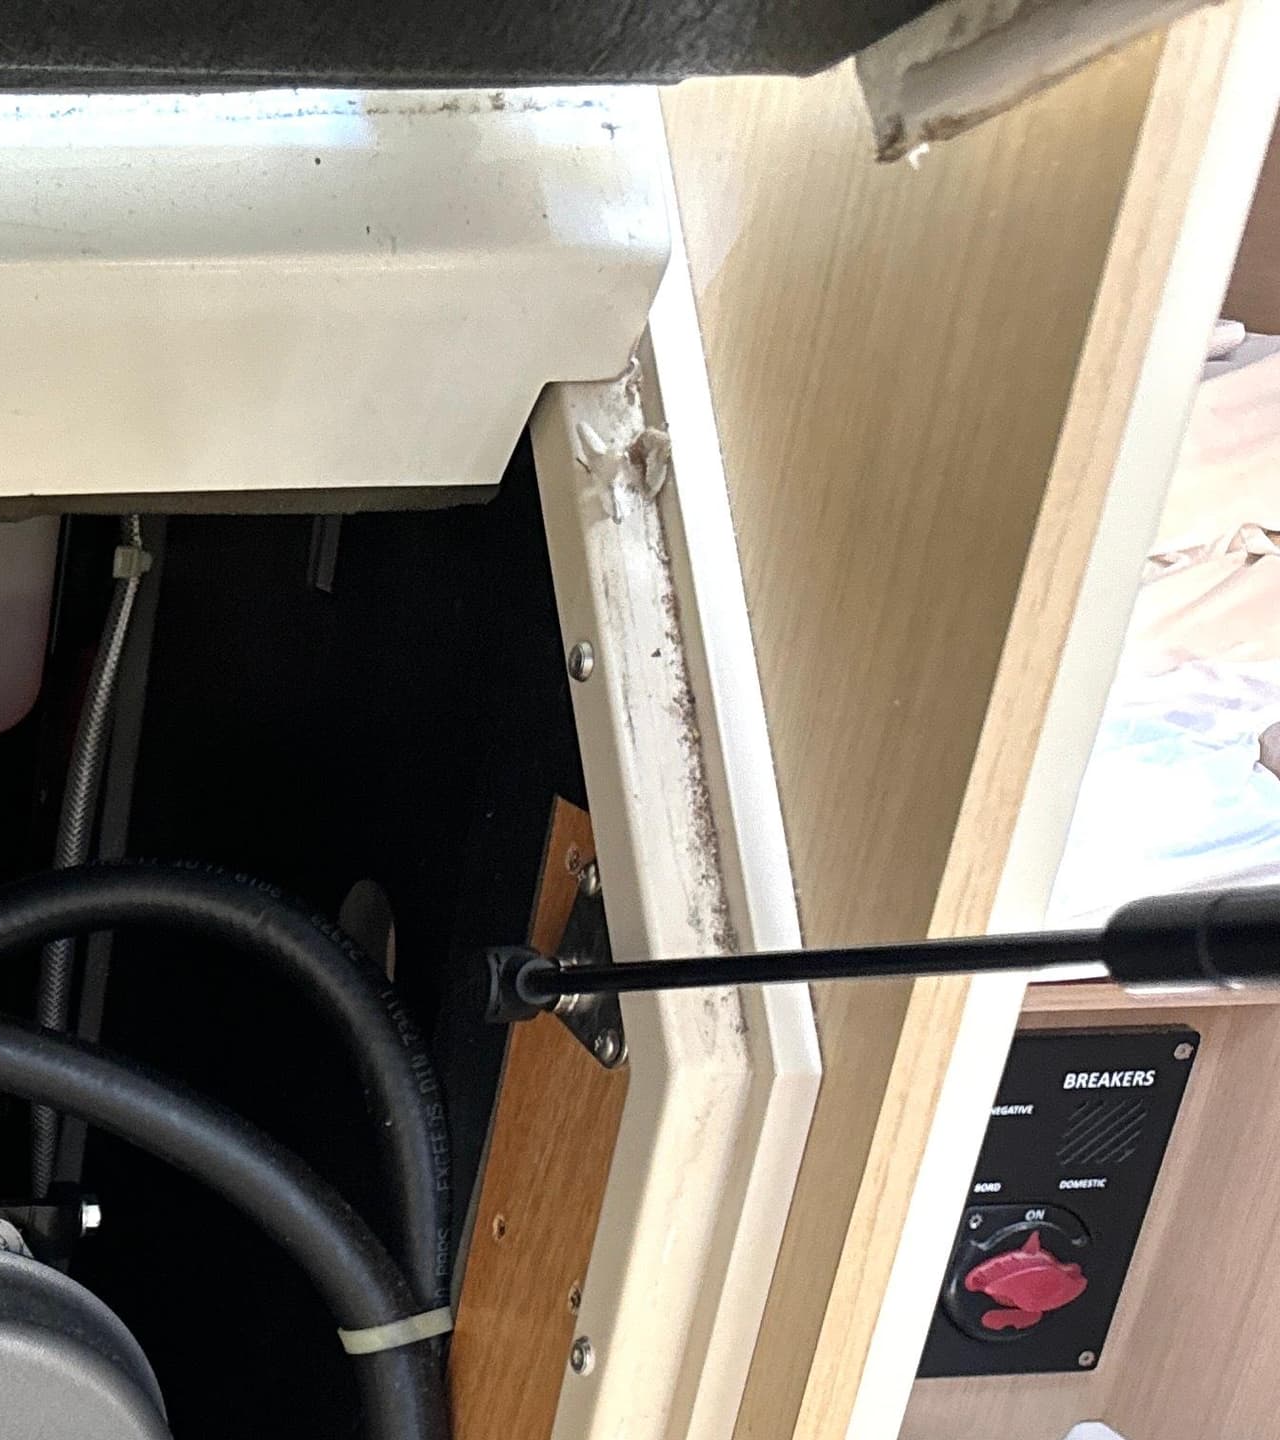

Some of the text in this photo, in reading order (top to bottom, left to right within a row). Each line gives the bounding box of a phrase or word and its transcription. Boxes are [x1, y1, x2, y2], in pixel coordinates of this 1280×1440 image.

[1063, 1070, 1156, 1089] BREAKERS
[1059, 1178, 1107, 1190] DOMESTIC
[1025, 1208, 1046, 1222] ON
